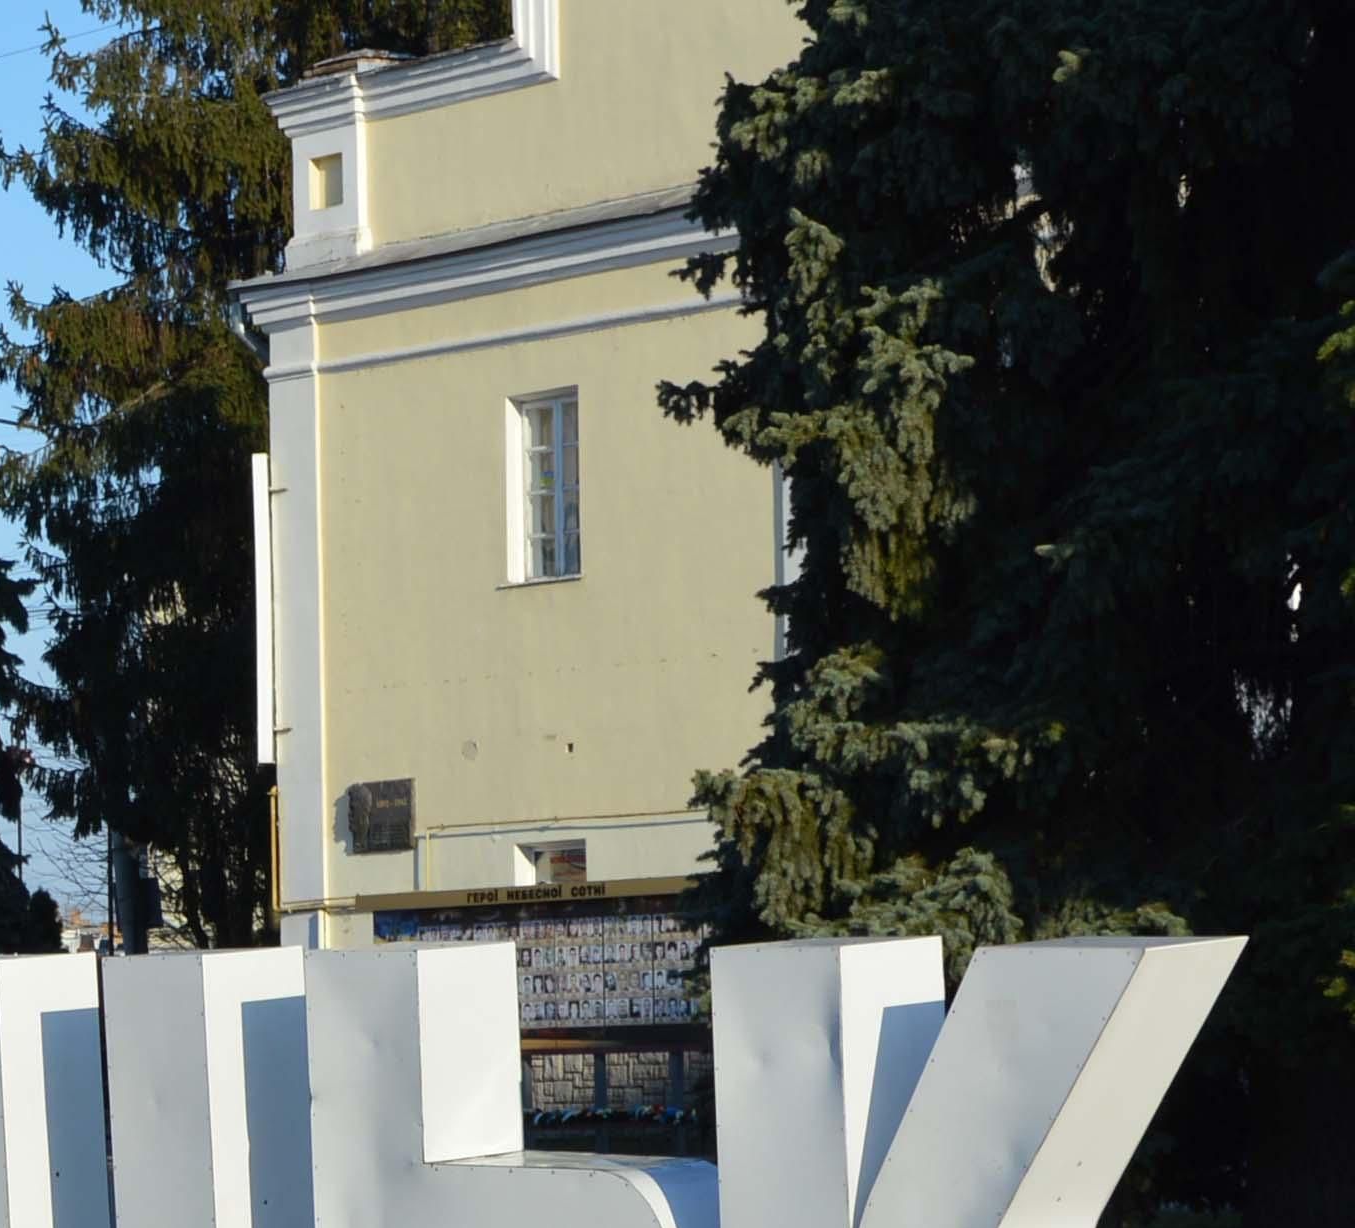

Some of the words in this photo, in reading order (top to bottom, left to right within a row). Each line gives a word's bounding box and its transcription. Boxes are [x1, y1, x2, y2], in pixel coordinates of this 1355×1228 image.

[466, 889, 499, 904] ГЕРОЇ
[506, 884, 563, 900] НЕБЕСНОЇ
[570, 882, 606, 897] СОТНІ
